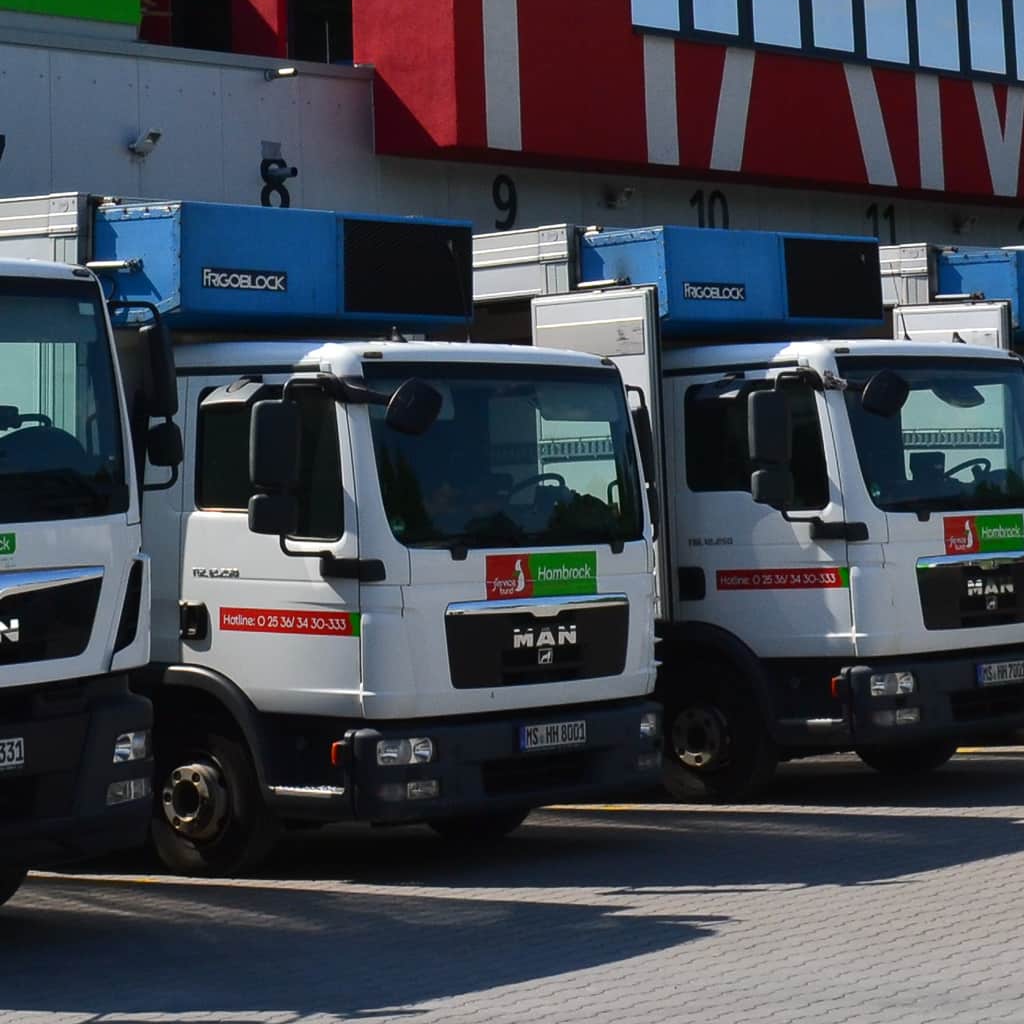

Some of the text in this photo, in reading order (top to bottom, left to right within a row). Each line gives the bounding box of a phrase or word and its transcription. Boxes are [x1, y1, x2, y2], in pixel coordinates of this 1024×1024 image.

[492, 174, 517, 230] 9
[689, 189, 729, 229] 10
[866, 203, 896, 243] 11
[203, 268, 286, 291] FRIGOBLOCK
[684, 282, 745, 301] FRIGOBLOCK
[981, 524, 1021, 538] Hambrock
[537, 563, 592, 582] Hambrock
[762, 575, 772, 585] 25
[790, 574, 801, 584] 34
[223, 614, 256, 626] Hotline:
[267, 616, 279, 626] 25
[280, 616, 295, 628] 36/
[297, 617, 309, 628] 34
[310, 617, 347, 630] 30-333
[513, 624, 577, 649] MAN
[545, 724, 559, 744] HH
